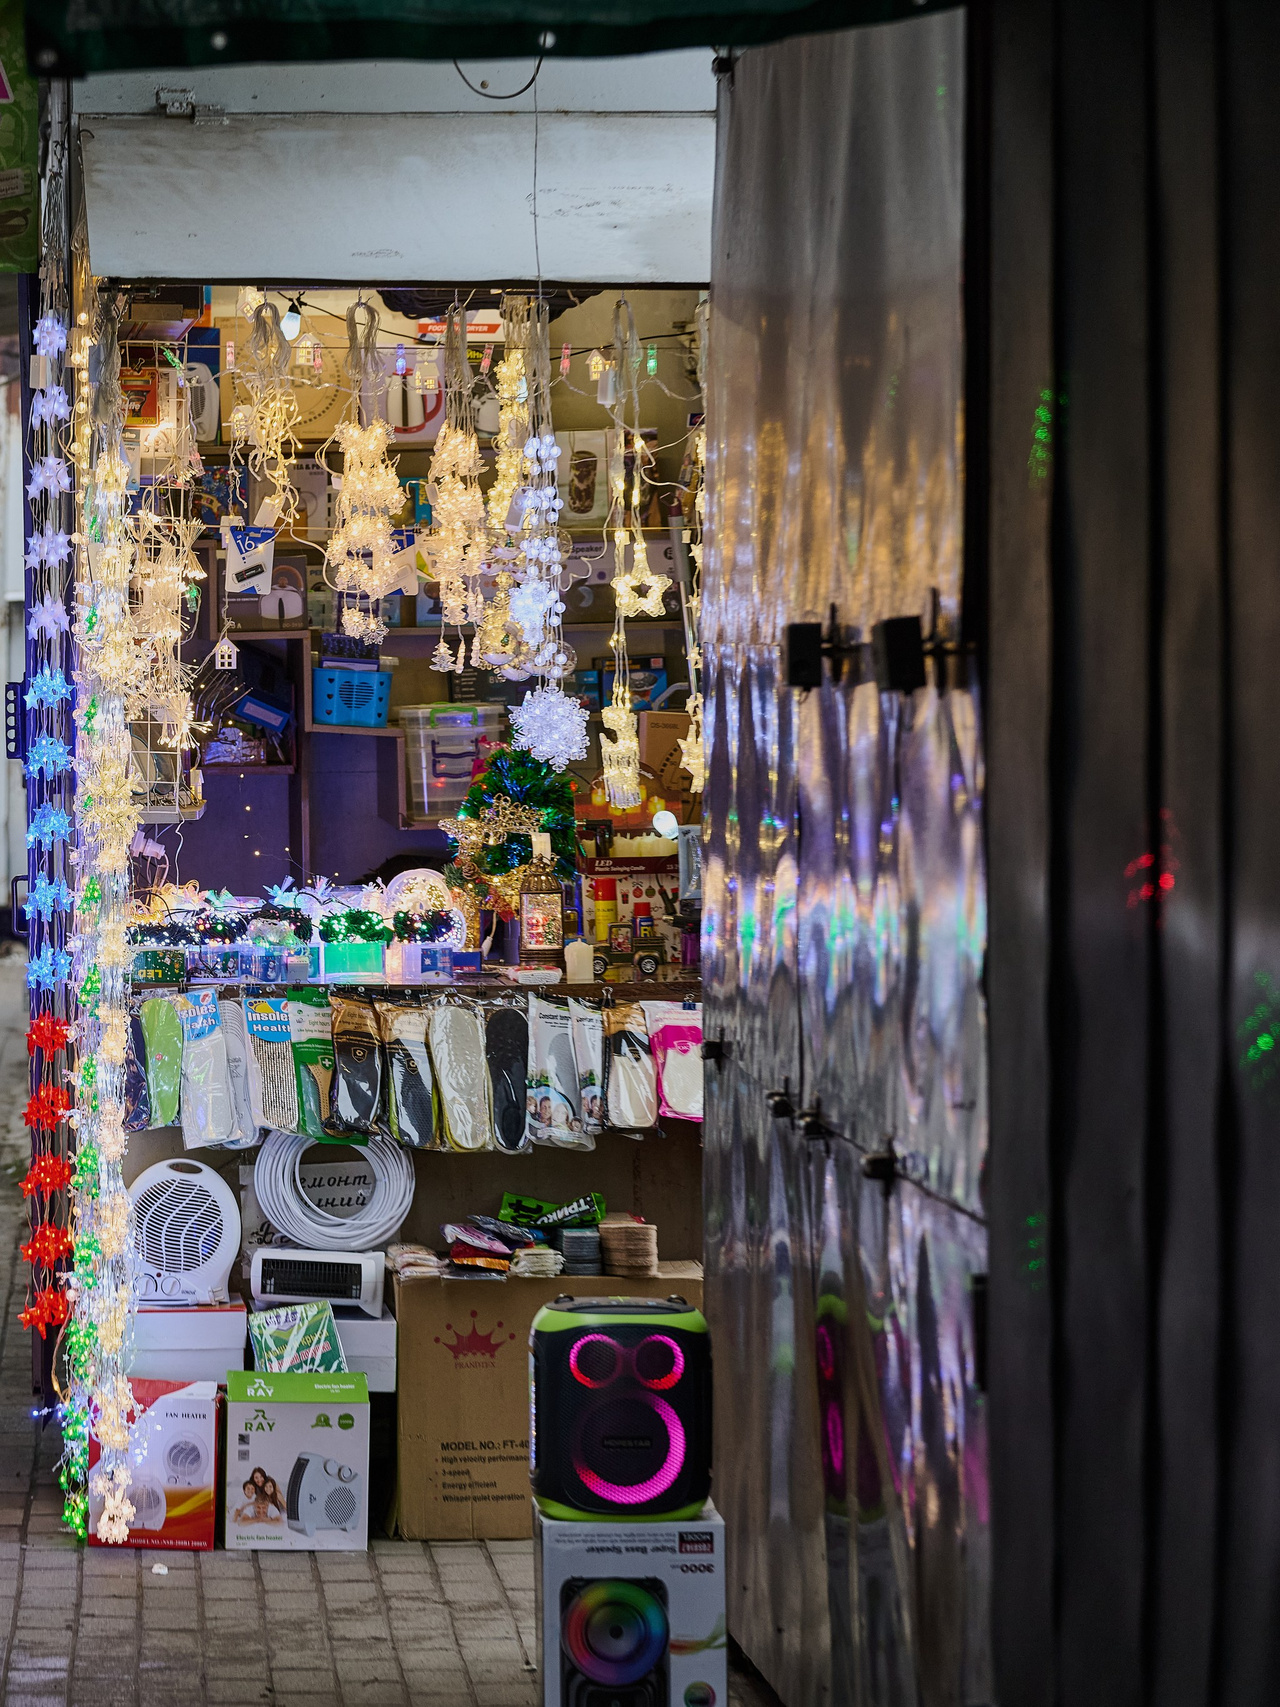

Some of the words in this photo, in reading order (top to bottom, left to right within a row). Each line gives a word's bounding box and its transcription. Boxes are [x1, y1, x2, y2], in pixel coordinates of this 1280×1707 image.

[236, 537, 255, 554] 16
[571, 546, 603, 555] Speaker
[595, 859, 613, 867] LED
[138, 969, 162, 978] LED
[247, 1011, 290, 1021] Insole
[299, 1174, 372, 1189] емонт
[247, 1388, 274, 1397] RAY
[181, 1412, 207, 1420] HEATER
[244, 1422, 276, 1432] RAY
[441, 1441, 478, 1452] MODEL
[441, 1456, 459, 1466] High
[459, 1455, 486, 1465] velocity
[442, 1481, 467, 1490] Energy
[442, 1495, 471, 1504] Whisper
[473, 1494, 491, 1503] quiet
[491, 1493, 526, 1502] operation
